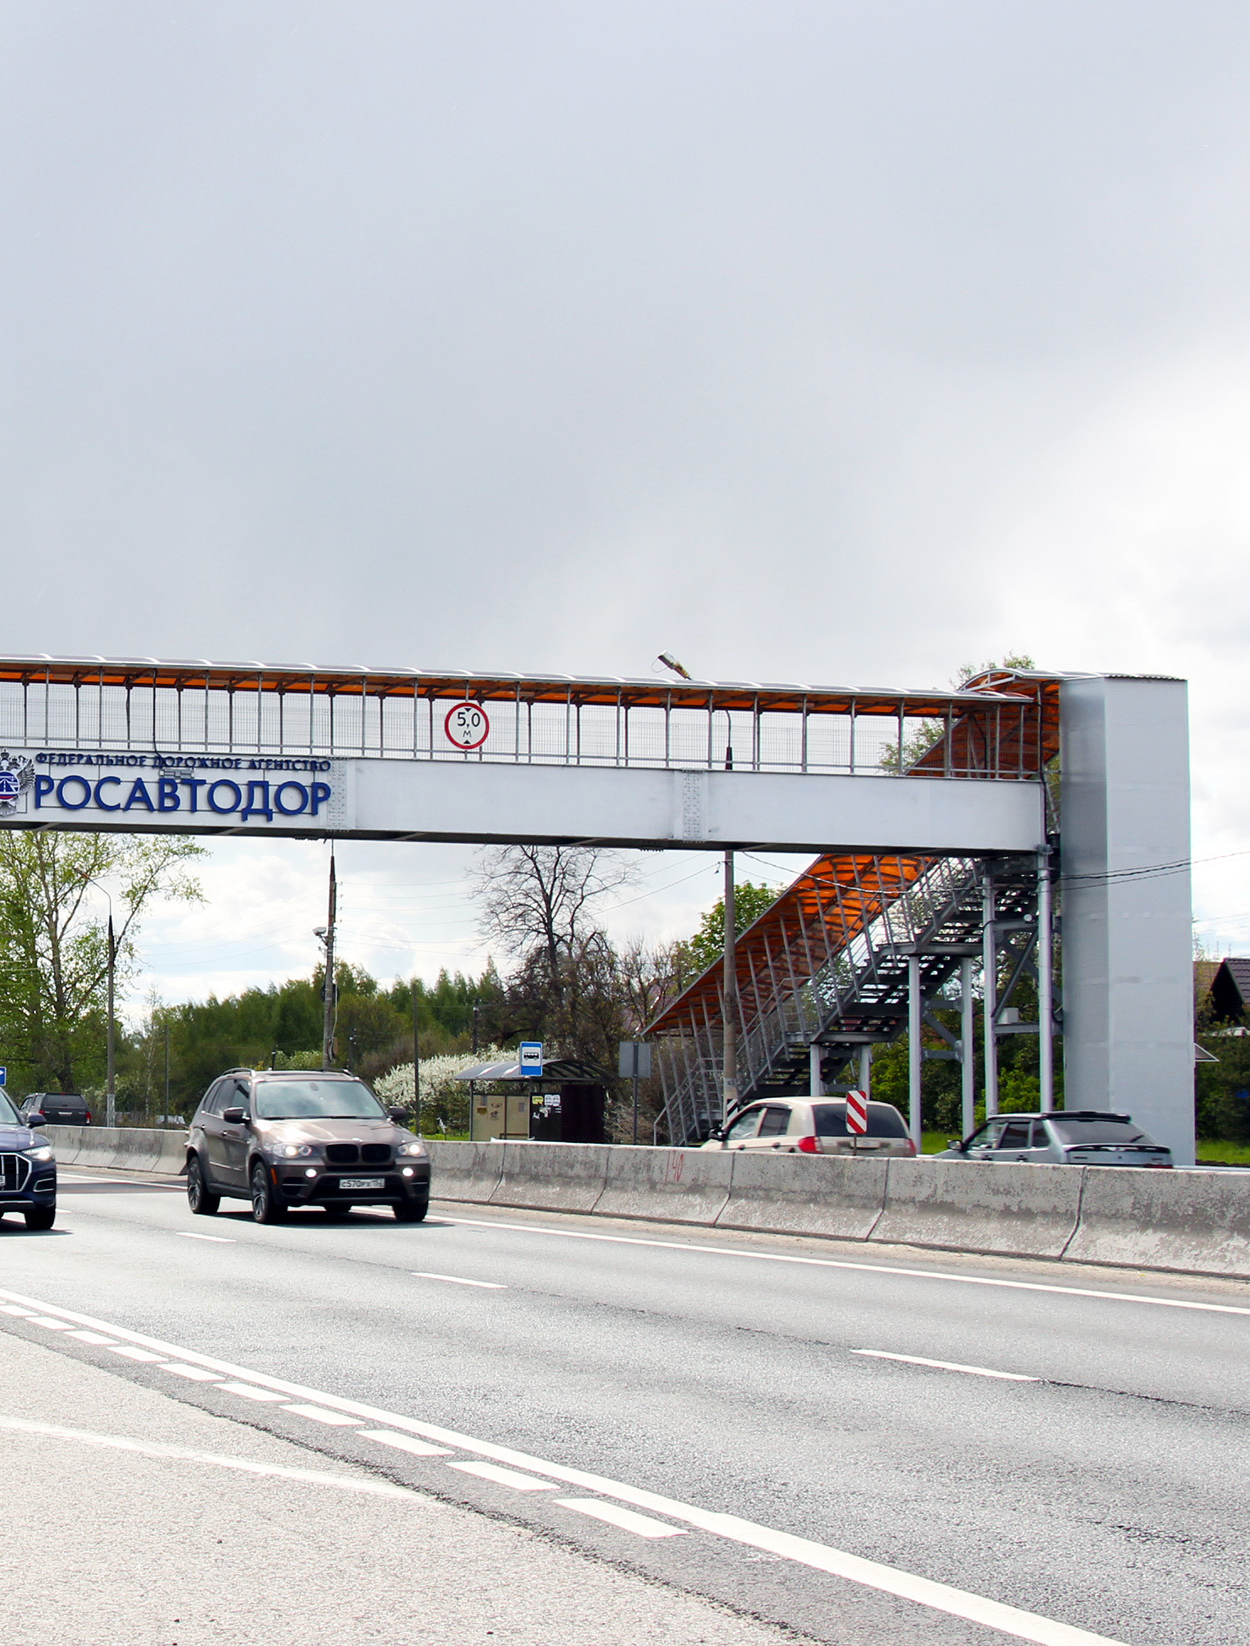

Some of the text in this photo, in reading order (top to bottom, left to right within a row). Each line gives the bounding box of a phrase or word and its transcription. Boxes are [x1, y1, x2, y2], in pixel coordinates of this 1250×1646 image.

[457, 712, 481, 729] 5,0
[35, 752, 331, 772] ФЕДЕРАЛЬНОЕ ДОРОЖНОЕ АГЕНТСТВО
[34, 774, 332, 822] РОСАВТОДОР
